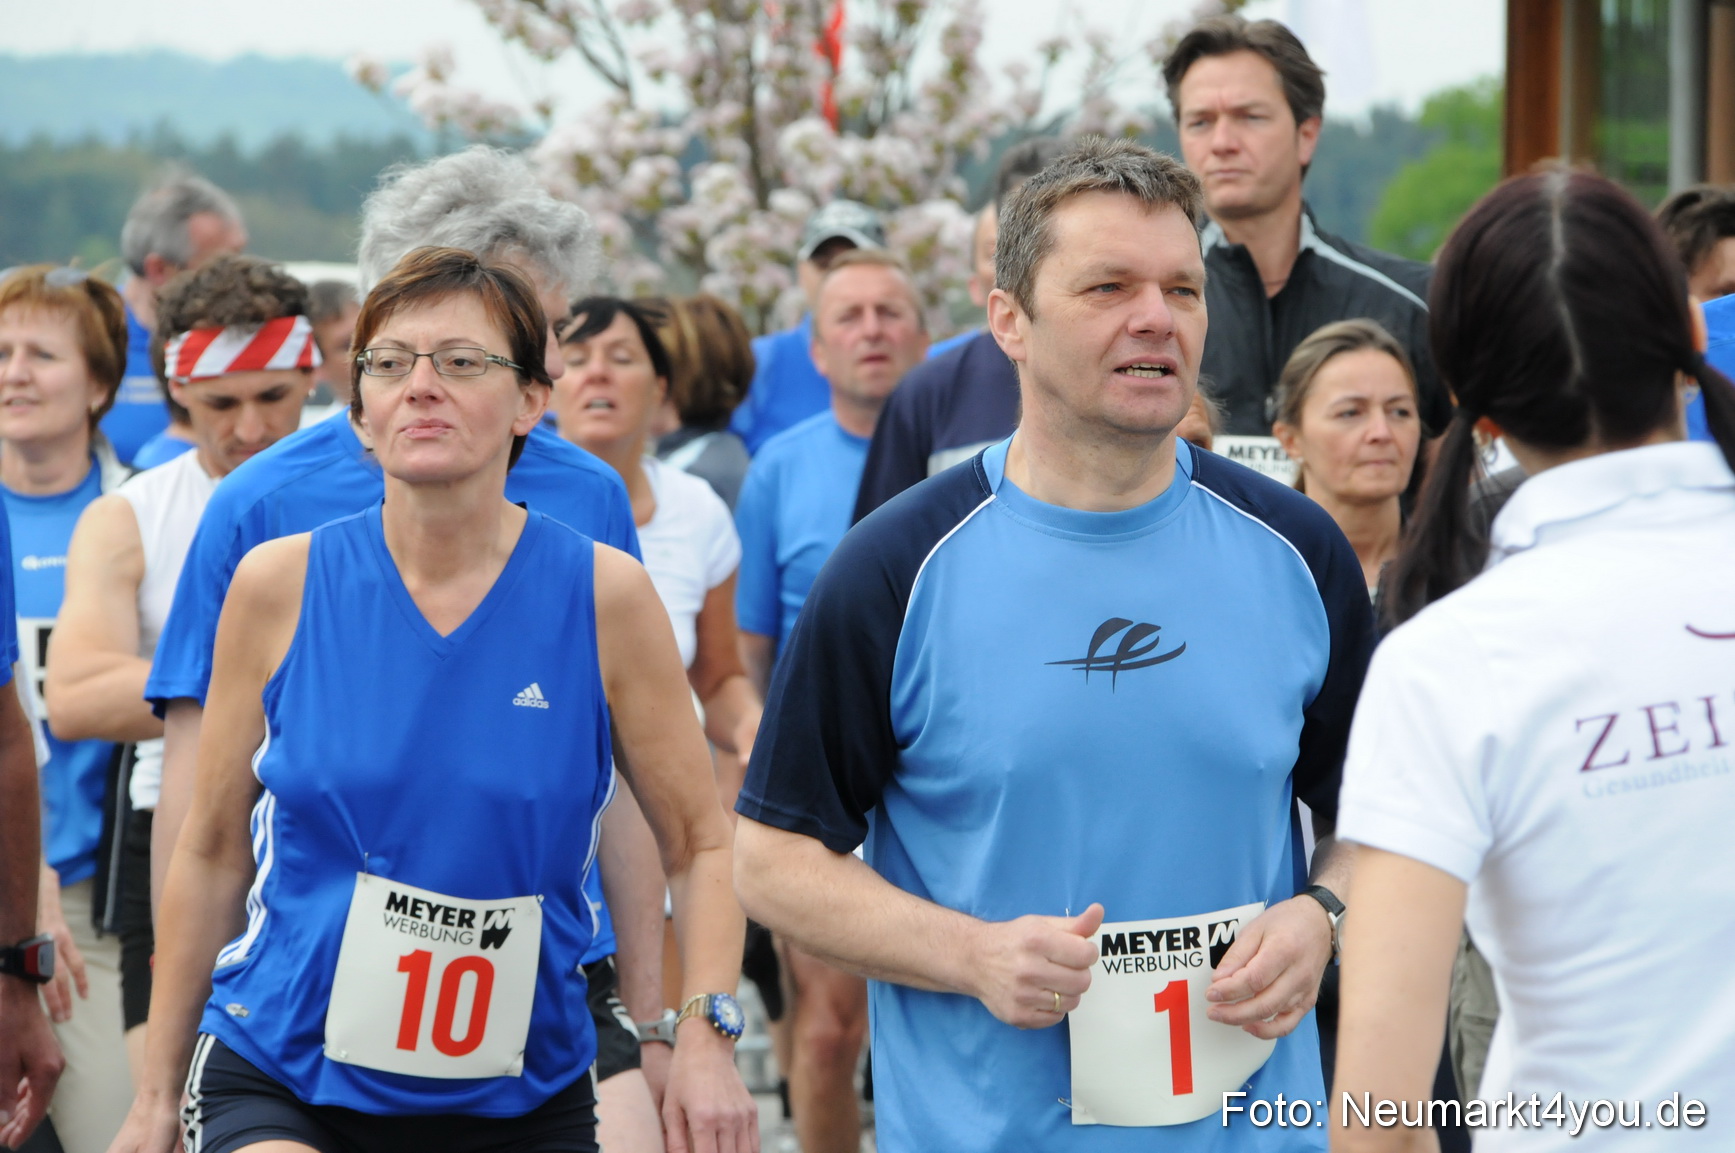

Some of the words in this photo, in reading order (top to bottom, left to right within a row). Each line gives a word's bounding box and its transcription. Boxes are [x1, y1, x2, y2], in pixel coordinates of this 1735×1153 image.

[1229, 445, 1289, 461] MEYE
[512, 697, 549, 709] adidas
[1575, 694, 1735, 773] ZEI
[385, 891, 476, 929] MEYER
[383, 912, 474, 945] WERBUNG
[1101, 926, 1202, 957] MEYER
[1102, 951, 1204, 975] WERBUNG
[396, 948, 495, 1057] 10
[1153, 979, 1193, 1096] 1
